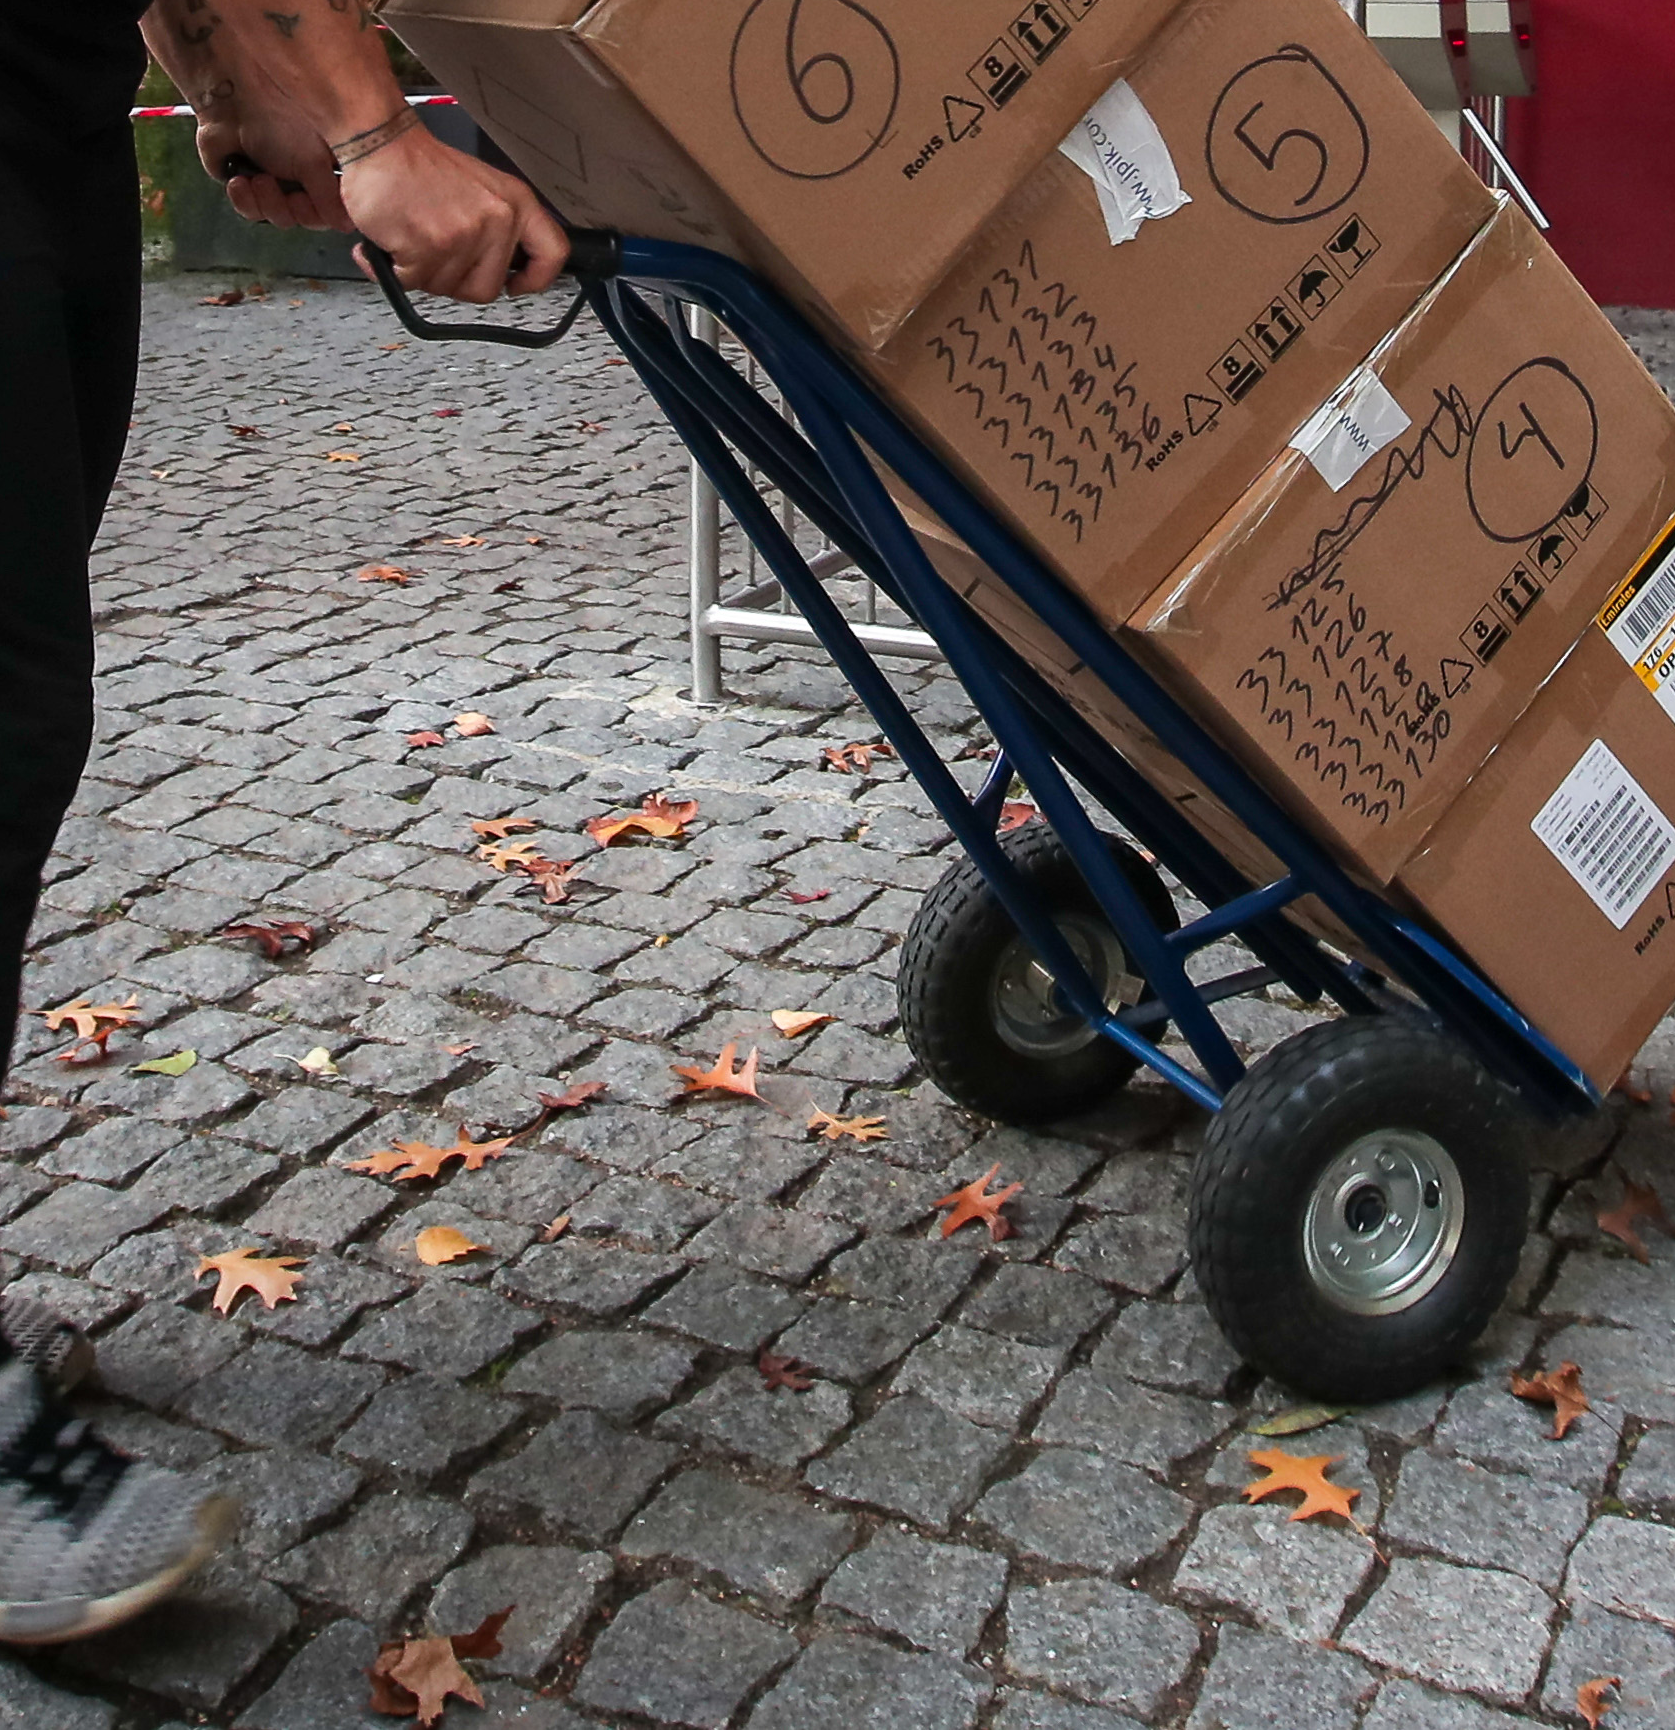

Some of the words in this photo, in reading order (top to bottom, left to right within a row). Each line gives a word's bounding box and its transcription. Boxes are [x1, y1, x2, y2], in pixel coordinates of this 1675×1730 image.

[984, 56, 1004, 78] 8
[902, 134, 945, 180] RoHS
[1234, 101, 1328, 206] 5
[1222, 356, 1241, 376] 8
[1144, 430, 1184, 472] RoHS
[1498, 402, 1566, 470] 4
[1473, 621, 1489, 639] 8
[1634, 914, 1666, 956] RoHS
